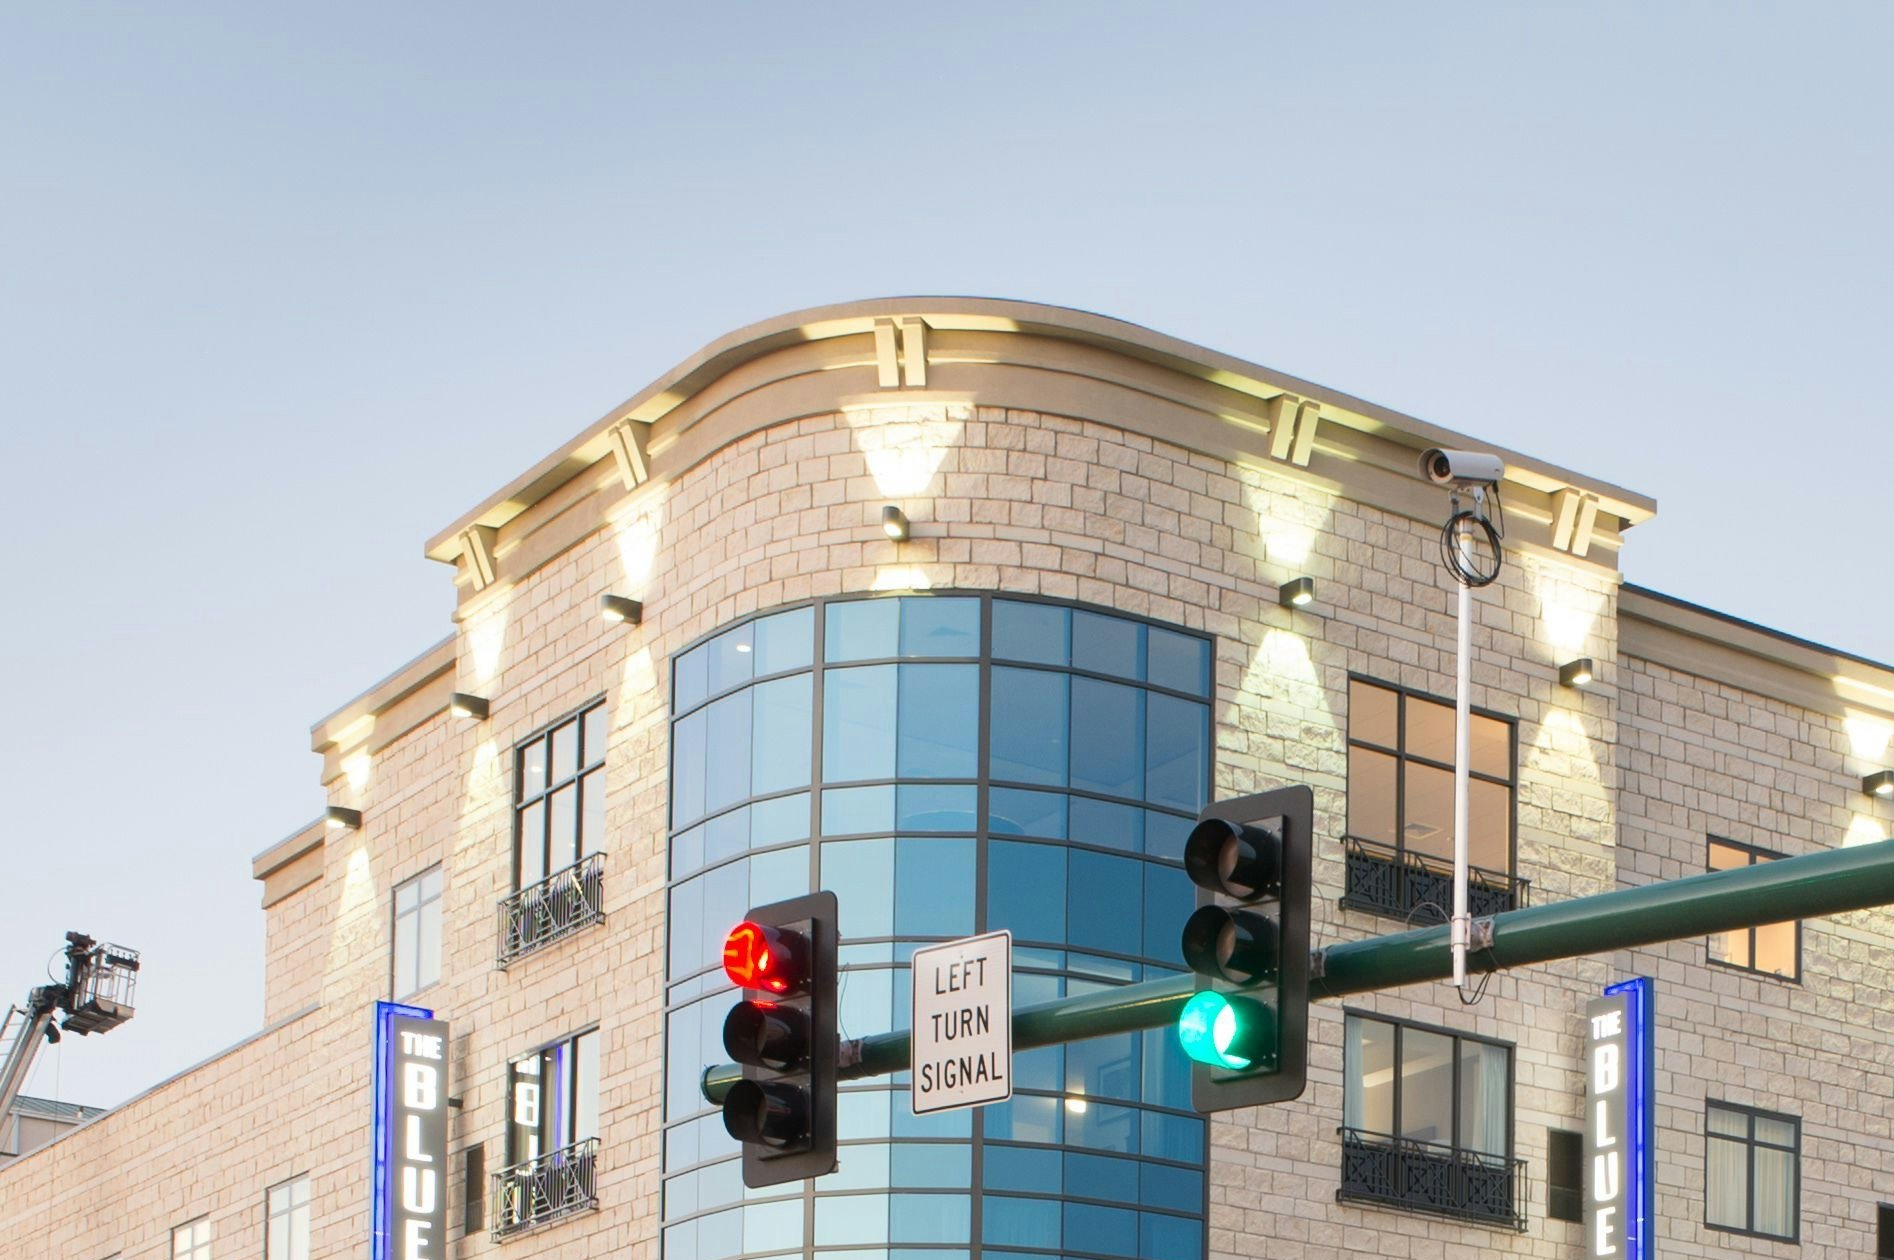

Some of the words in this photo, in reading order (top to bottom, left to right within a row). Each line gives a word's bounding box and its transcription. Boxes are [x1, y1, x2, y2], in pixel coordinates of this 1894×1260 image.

[935, 957, 988, 995] LEFT
[931, 1004, 989, 1043] TURN
[1591, 1009, 1622, 1041] THE
[400, 1030, 442, 1060] THE
[920, 1051, 1003, 1093] SIGNAL
